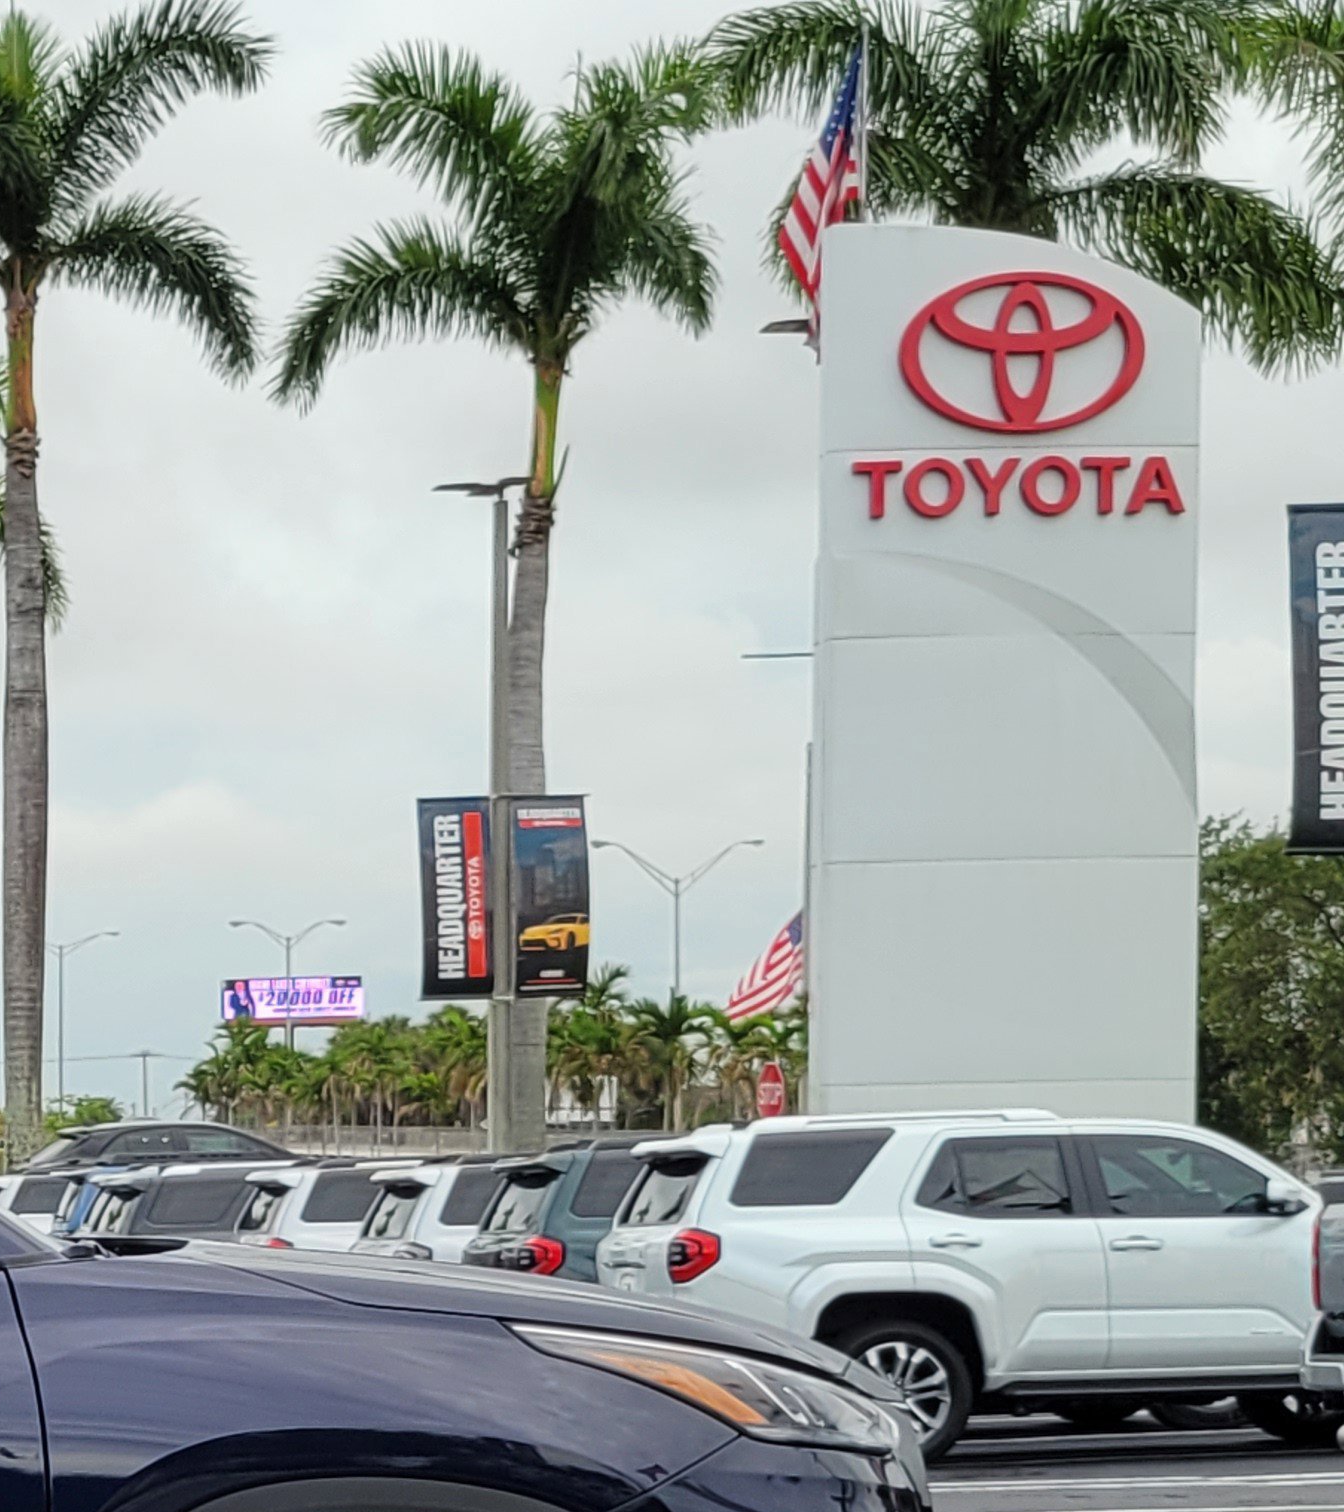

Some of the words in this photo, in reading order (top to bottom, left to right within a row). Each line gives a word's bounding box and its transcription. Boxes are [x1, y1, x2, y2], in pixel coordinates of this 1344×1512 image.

[852, 455, 1185, 519] TOYOTA
[433, 814, 466, 979] HEADQUARTER
[468, 856, 482, 917] TOYOTA
